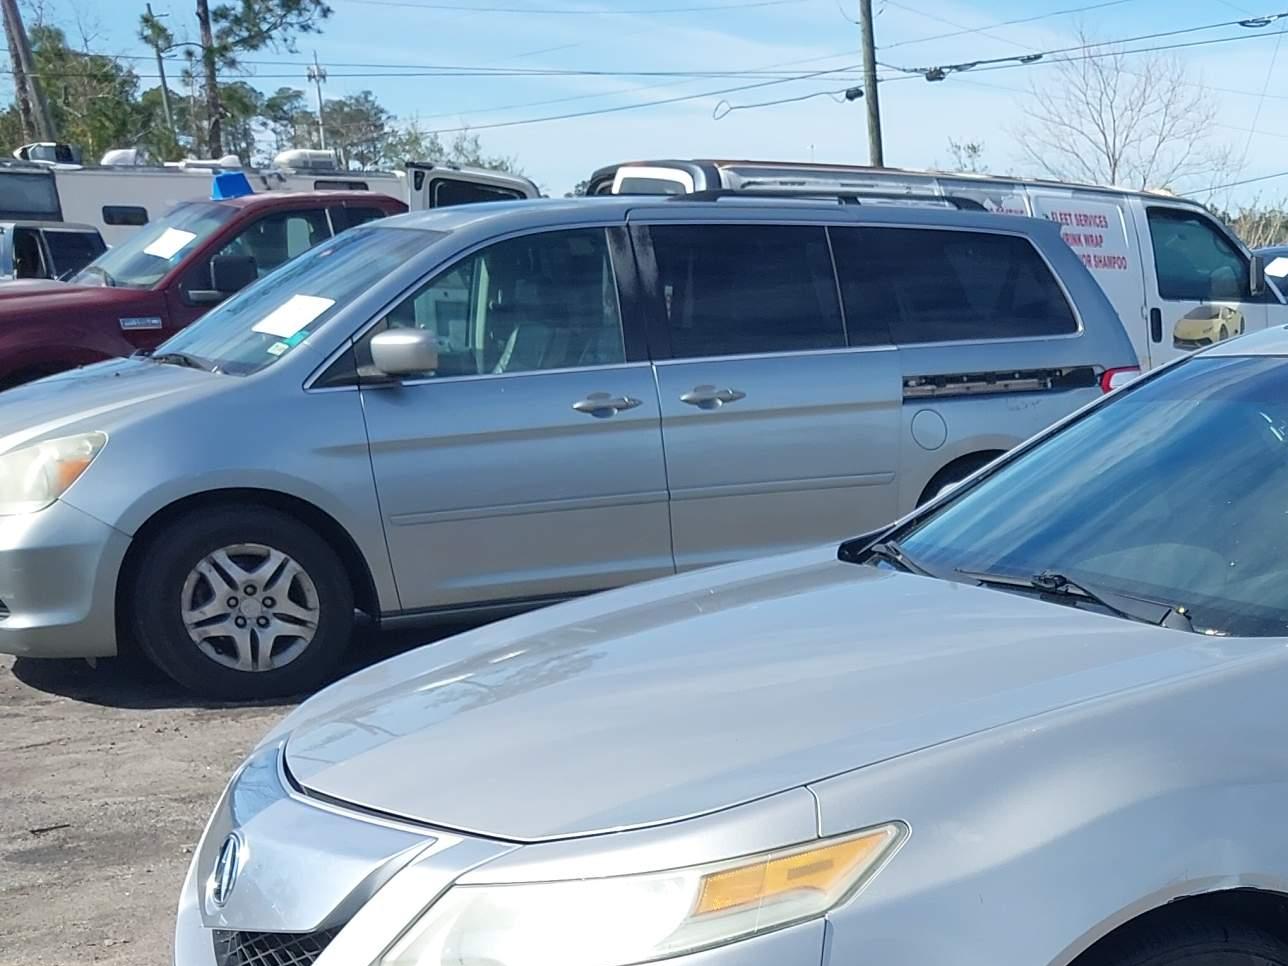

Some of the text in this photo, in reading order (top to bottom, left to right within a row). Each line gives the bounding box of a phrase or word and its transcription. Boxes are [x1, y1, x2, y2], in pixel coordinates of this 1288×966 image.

[1050, 211, 1109, 229] FLEET SERVICES
[1083, 233, 1104, 249] WRAP
[1093, 254, 1128, 271] SHAMPOO
